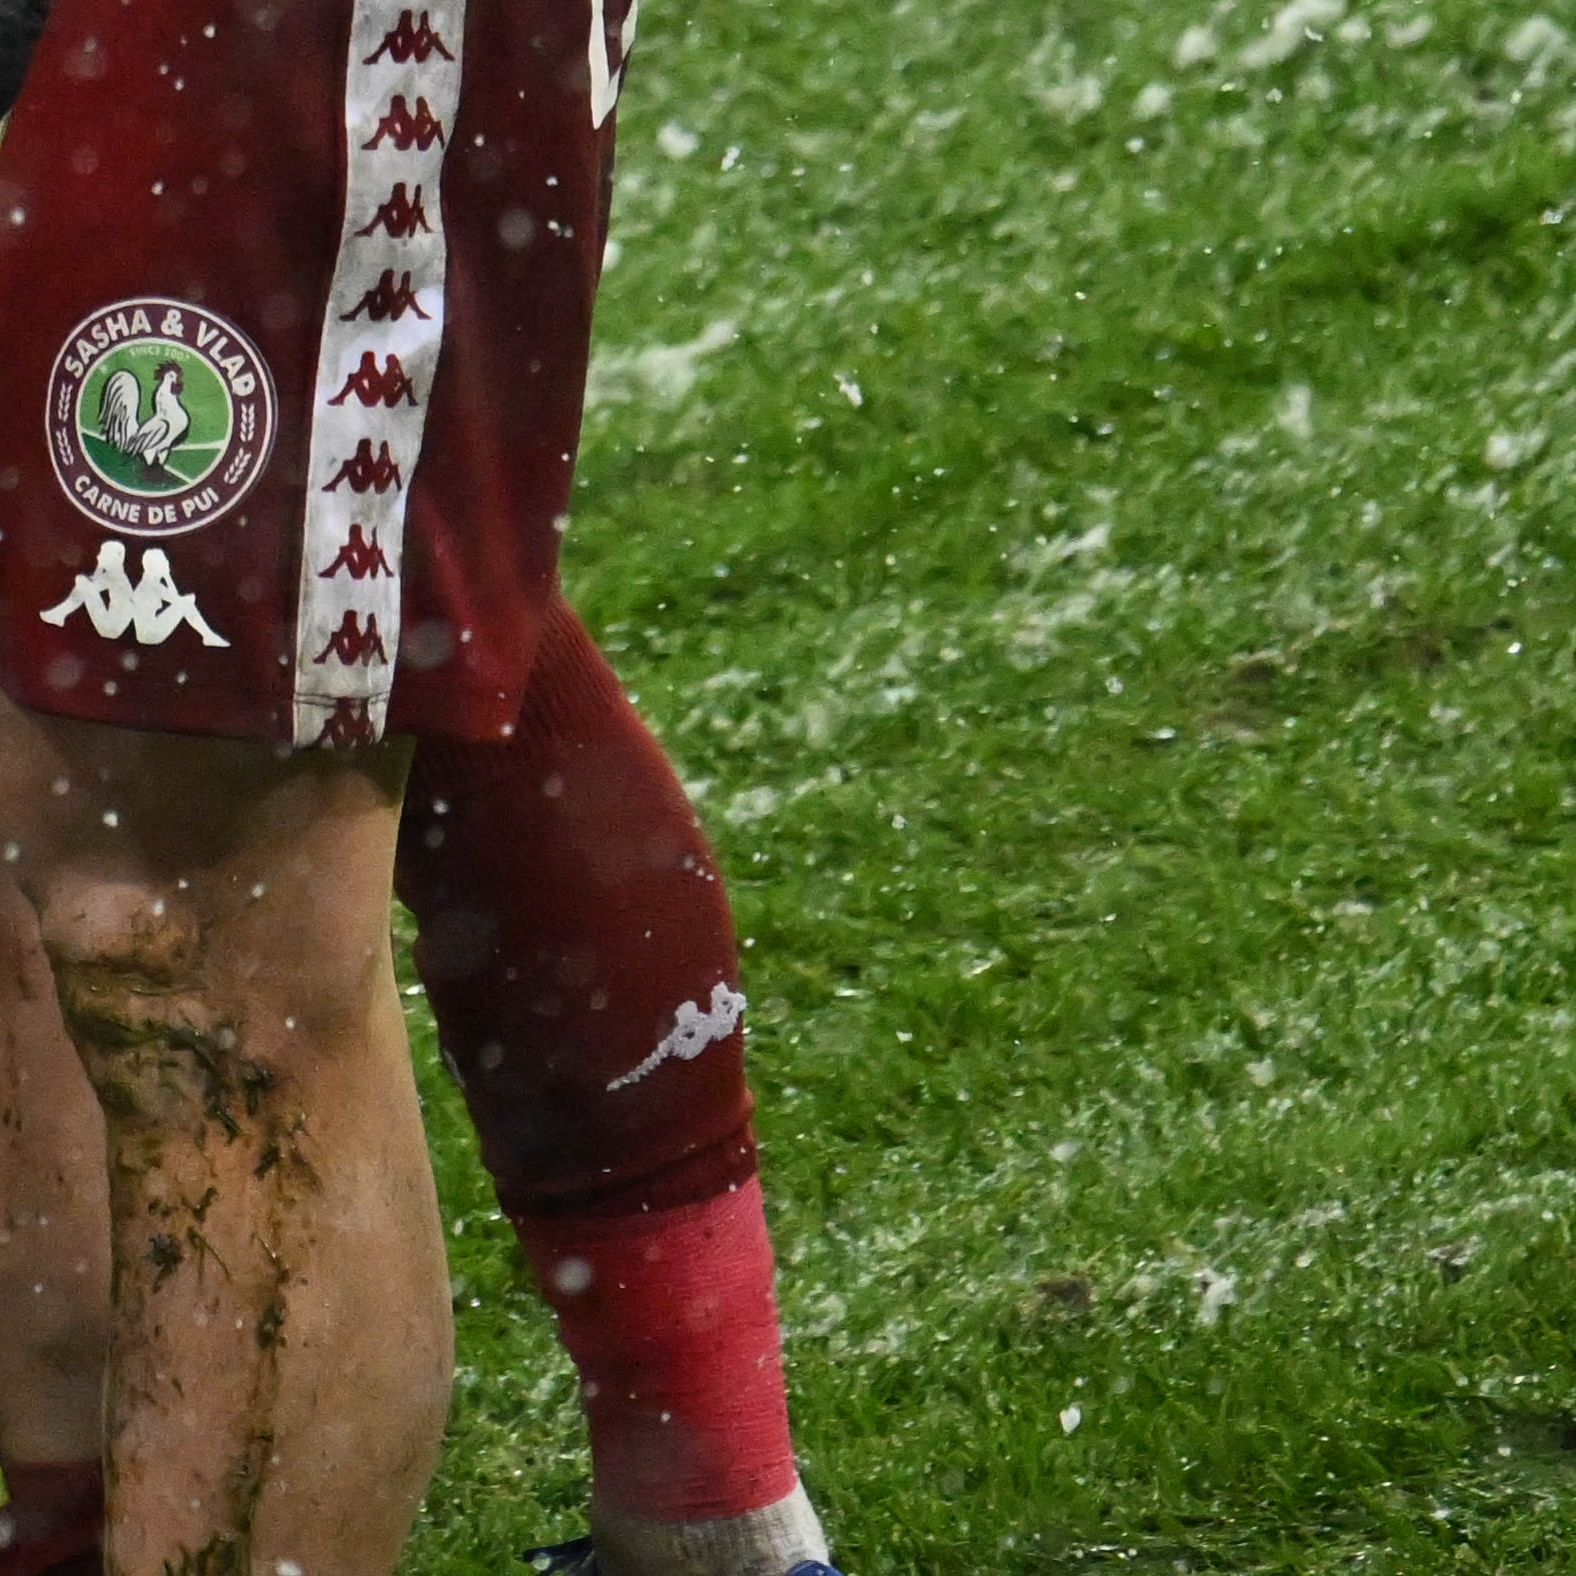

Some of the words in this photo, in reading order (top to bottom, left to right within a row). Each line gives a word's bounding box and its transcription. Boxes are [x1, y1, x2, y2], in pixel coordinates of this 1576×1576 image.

[64, 308, 153, 379] SASHA
[160, 308, 185, 339] &
[195, 320, 257, 397] VLAD
[74, 474, 142, 524] CARNE
[147, 504, 178, 525] DE
[180, 486, 220, 519] PUI
